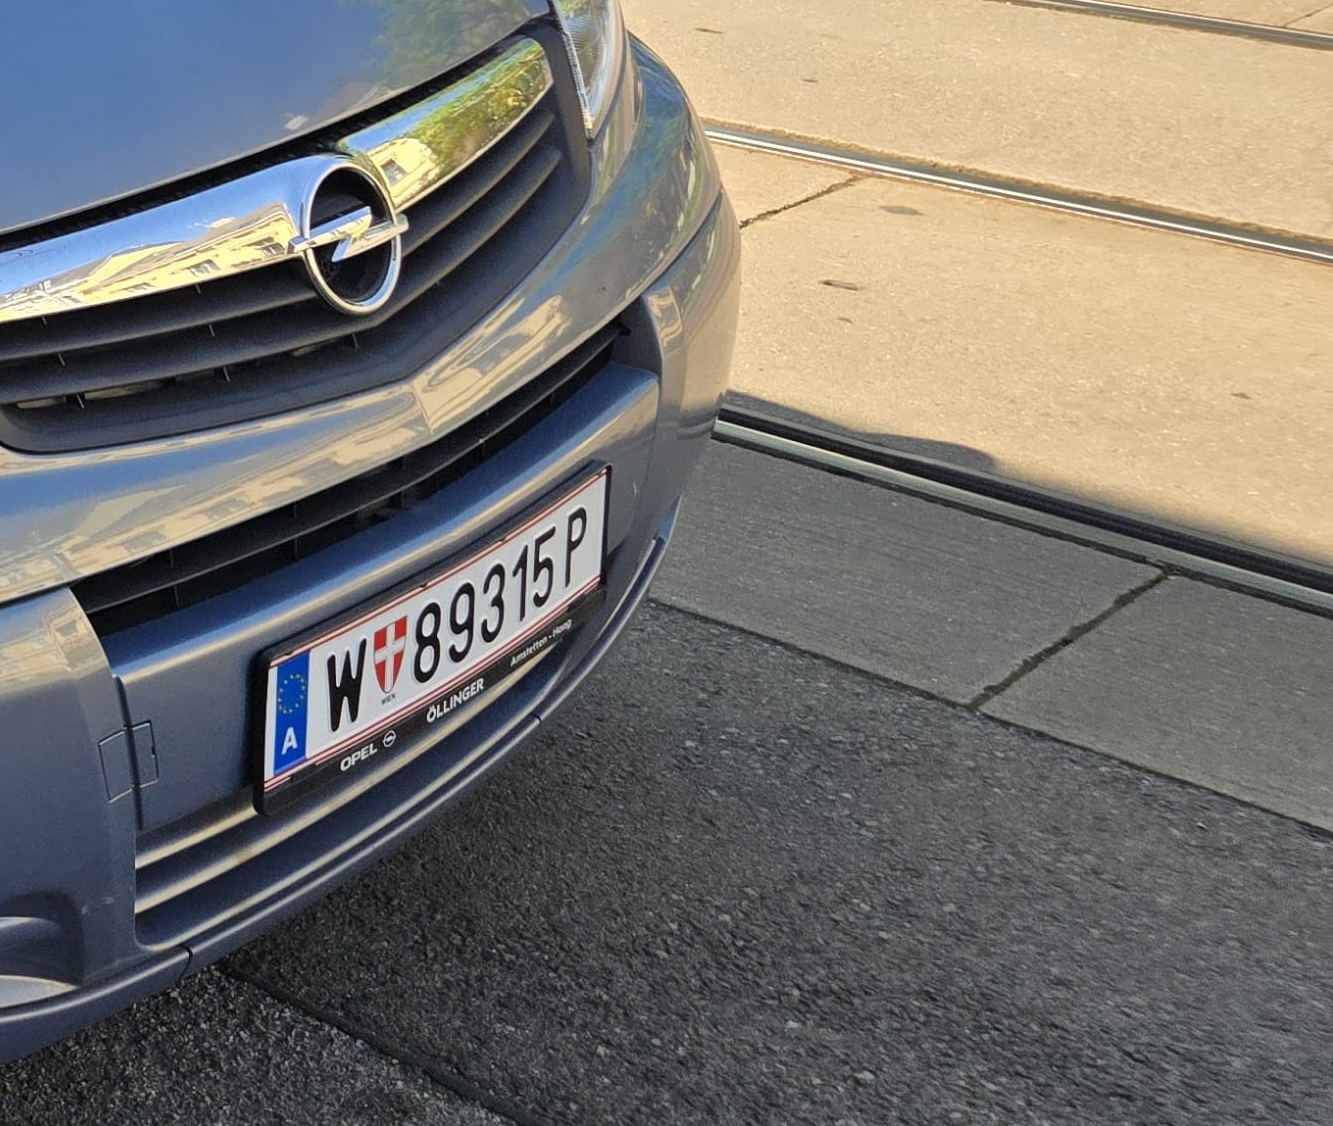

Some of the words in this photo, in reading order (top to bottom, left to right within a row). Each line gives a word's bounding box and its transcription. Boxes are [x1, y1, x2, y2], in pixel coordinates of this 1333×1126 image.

[510, 635, 548, 666] Amstetten
[553, 619, 572, 637] Haag
[327, 637, 367, 732] W
[281, 726, 298, 755] A
[340, 743, 378, 771] OPEL
[426, 678, 484, 723] ÖLLINGER
